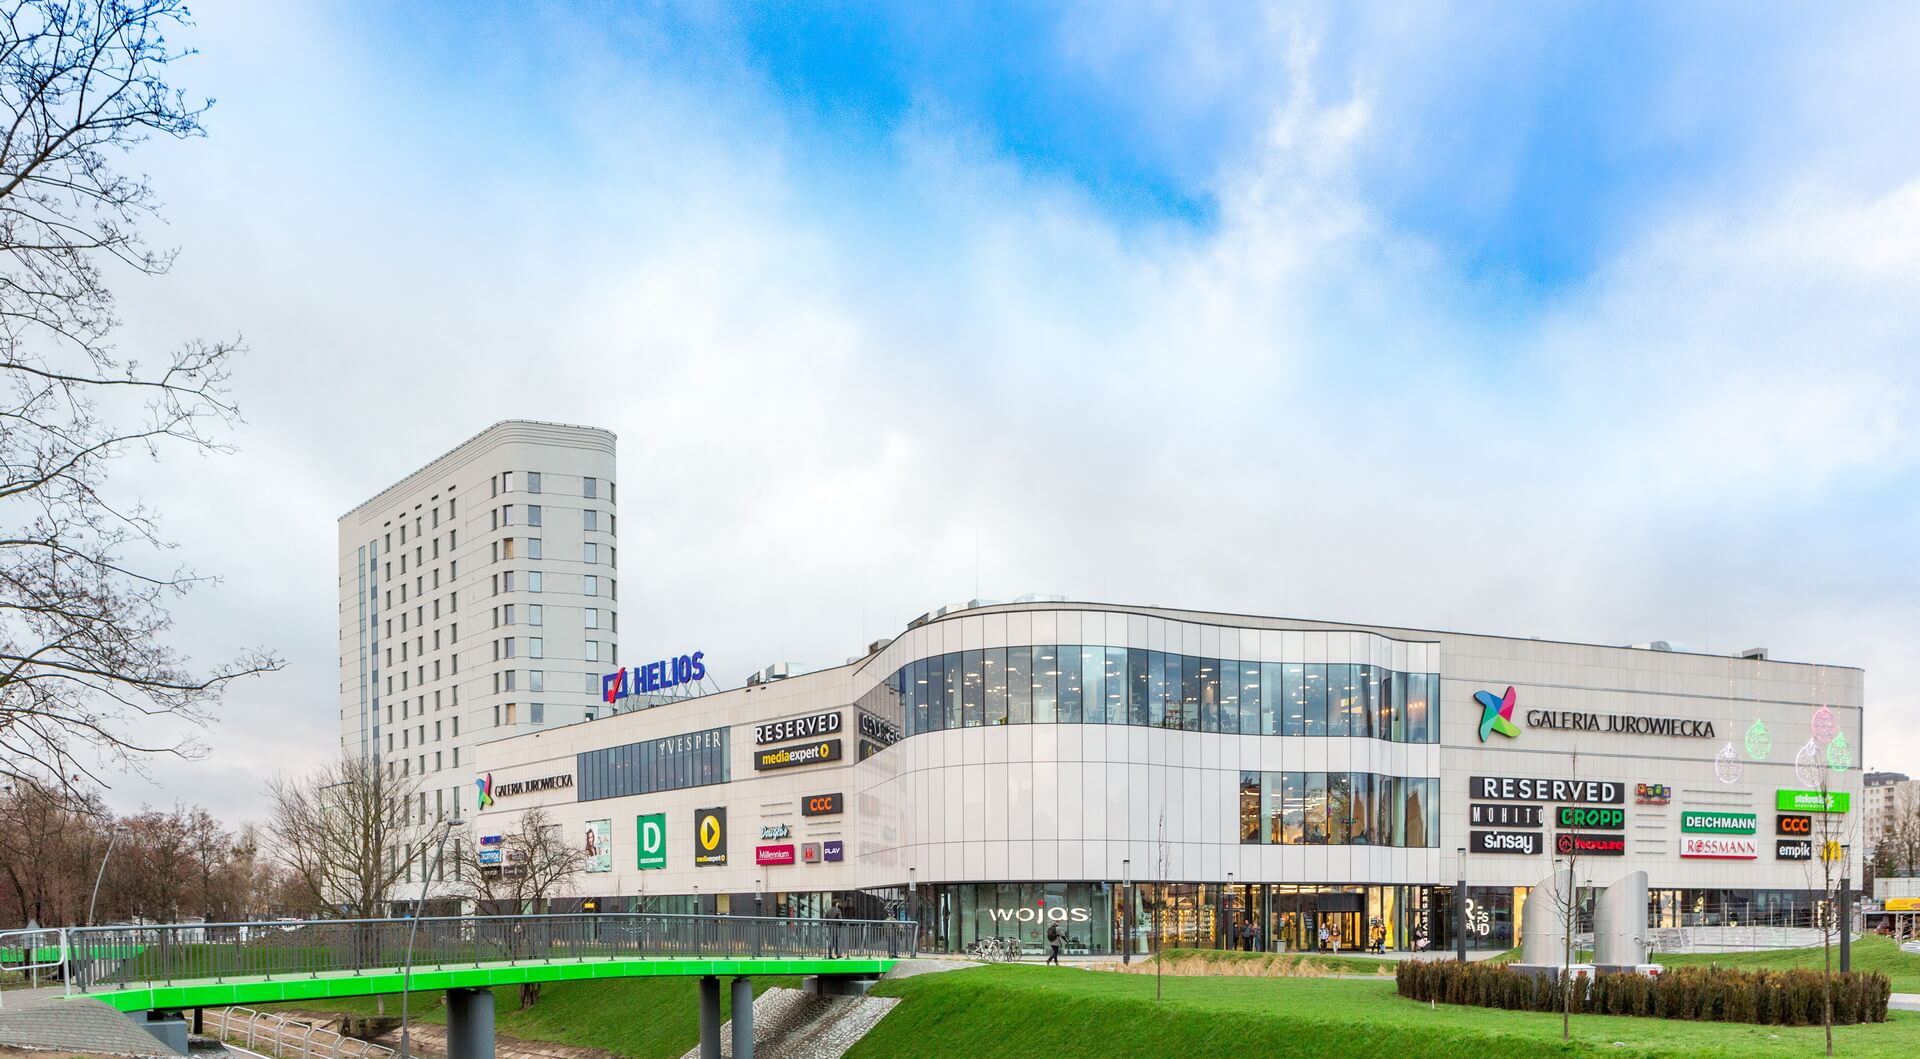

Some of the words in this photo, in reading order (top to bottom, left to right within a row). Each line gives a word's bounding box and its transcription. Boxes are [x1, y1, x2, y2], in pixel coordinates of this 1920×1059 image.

[634, 650, 705, 695] HELIOS
[755, 713, 839, 744] RESERVED
[1526, 709, 1600, 731] GALERIA
[1604, 714, 1715, 738] JUROWIECKA
[666, 731, 720, 754] VESPER
[762, 745, 819, 765] mediaexpert
[495, 781, 523, 797] GALERIA
[524, 773, 574, 794] JUROWIECKA
[1483, 778, 1615, 802] RESERVED
[809, 797, 833, 811] CCC
[1473, 807, 1544, 824] MOHITO
[1560, 808, 1623, 827] CROPP
[1686, 816, 1755, 829] DEICHMANN
[1781, 818, 1809, 832] CCC
[643, 822, 661, 853] D
[1484, 831, 1533, 854] sinsay
[1687, 839, 1755, 853] ROSSMANN
[1779, 842, 1811, 858] empik
[989, 899, 1090, 925] wojas
